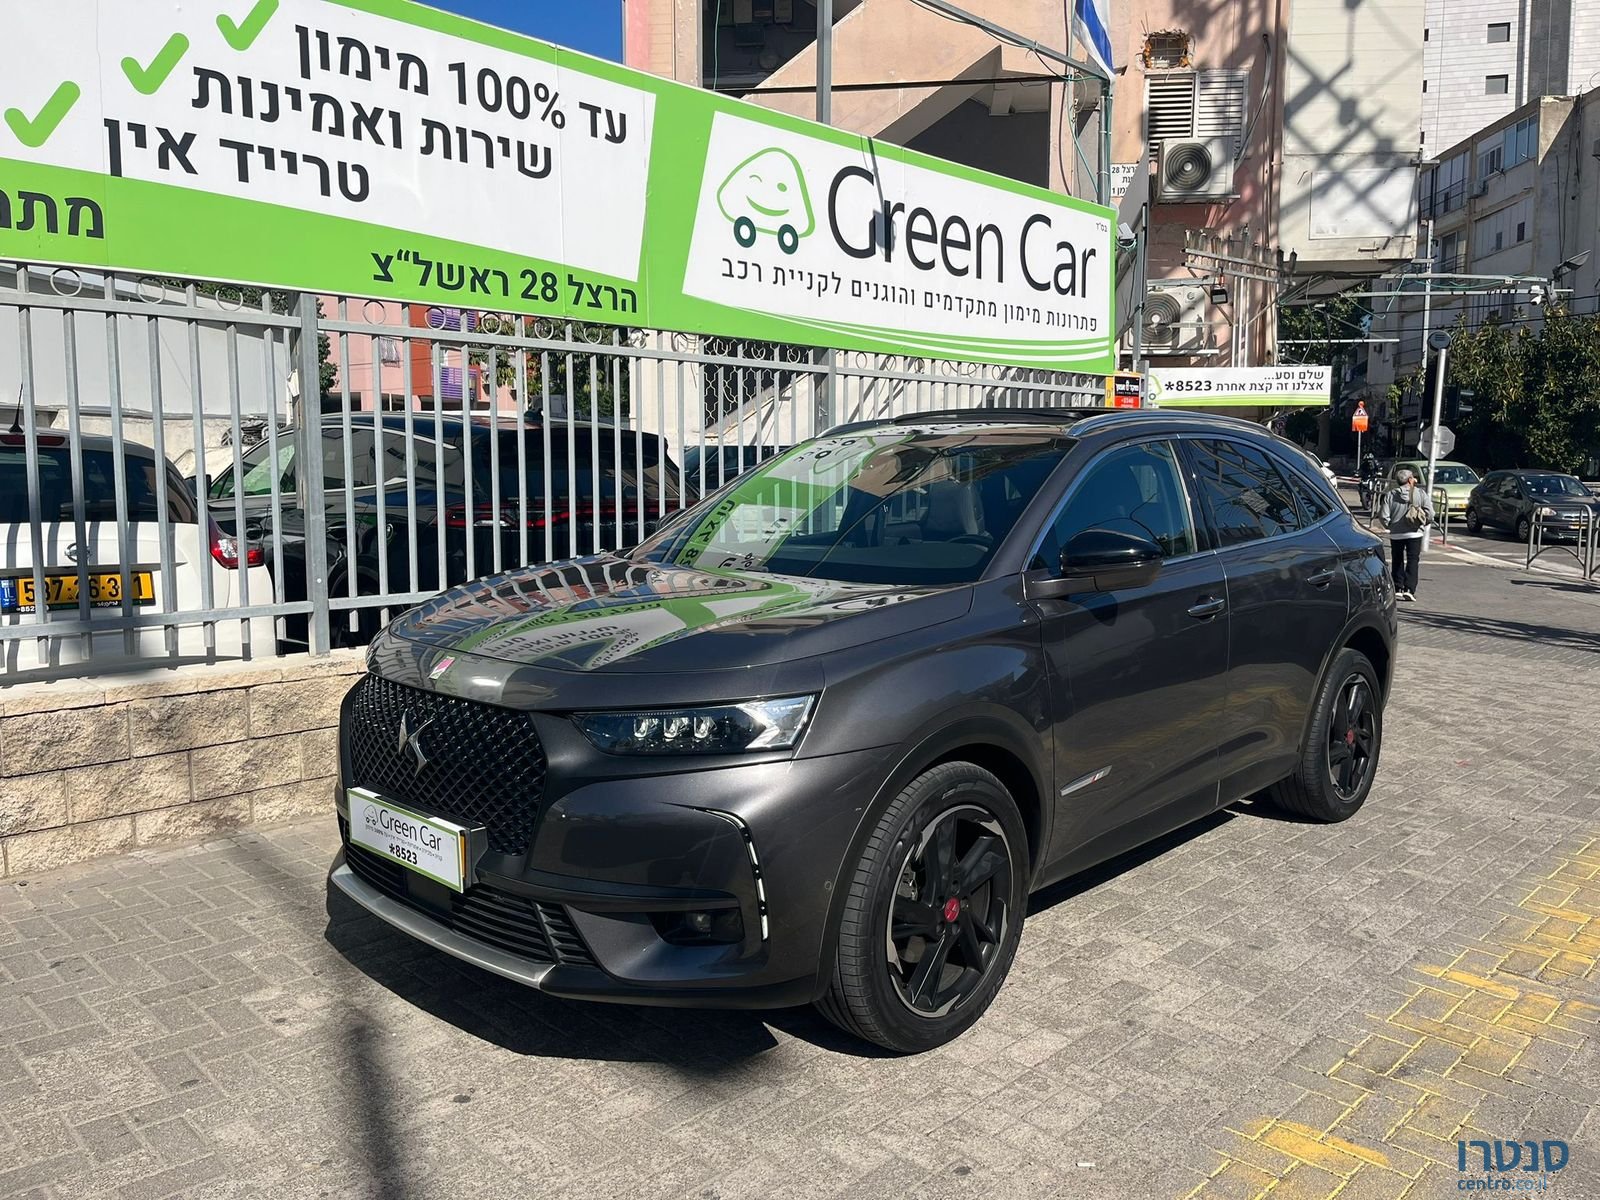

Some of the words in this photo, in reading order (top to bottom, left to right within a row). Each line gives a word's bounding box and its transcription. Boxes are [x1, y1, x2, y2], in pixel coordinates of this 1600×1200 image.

[295, 24, 429, 95] מימון
[191, 66, 402, 149] ואמינות
[448, 62, 565, 129] 100%
[578, 101, 627, 144] עד
[104, 118, 197, 176] אין
[421, 117, 552, 179] שירות
[220, 137, 370, 202] טרייד
[1122, 165, 1136, 173] רצל
[828, 166, 1004, 283] Green
[1020, 214, 1097, 298] Car
[722, 258, 762, 282] רכב
[773, 267, 842, 297] לקניית
[519, 269, 559, 306] 28
[567, 275, 637, 313] הרצל
[851, 280, 917, 307] והוגנים
[923, 292, 998, 318] מתקדמים
[1003, 303, 1041, 325] מימון
[1046, 310, 1097, 332] פתרונות
[1249, 383, 1273, 392] קצת
[1276, 382, 1288, 390] זה
[1292, 381, 1324, 391] אצלנו
[1298, 370, 1324, 380] שלם
[380, 809, 417, 841] Green
[420, 826, 441, 850] Car
